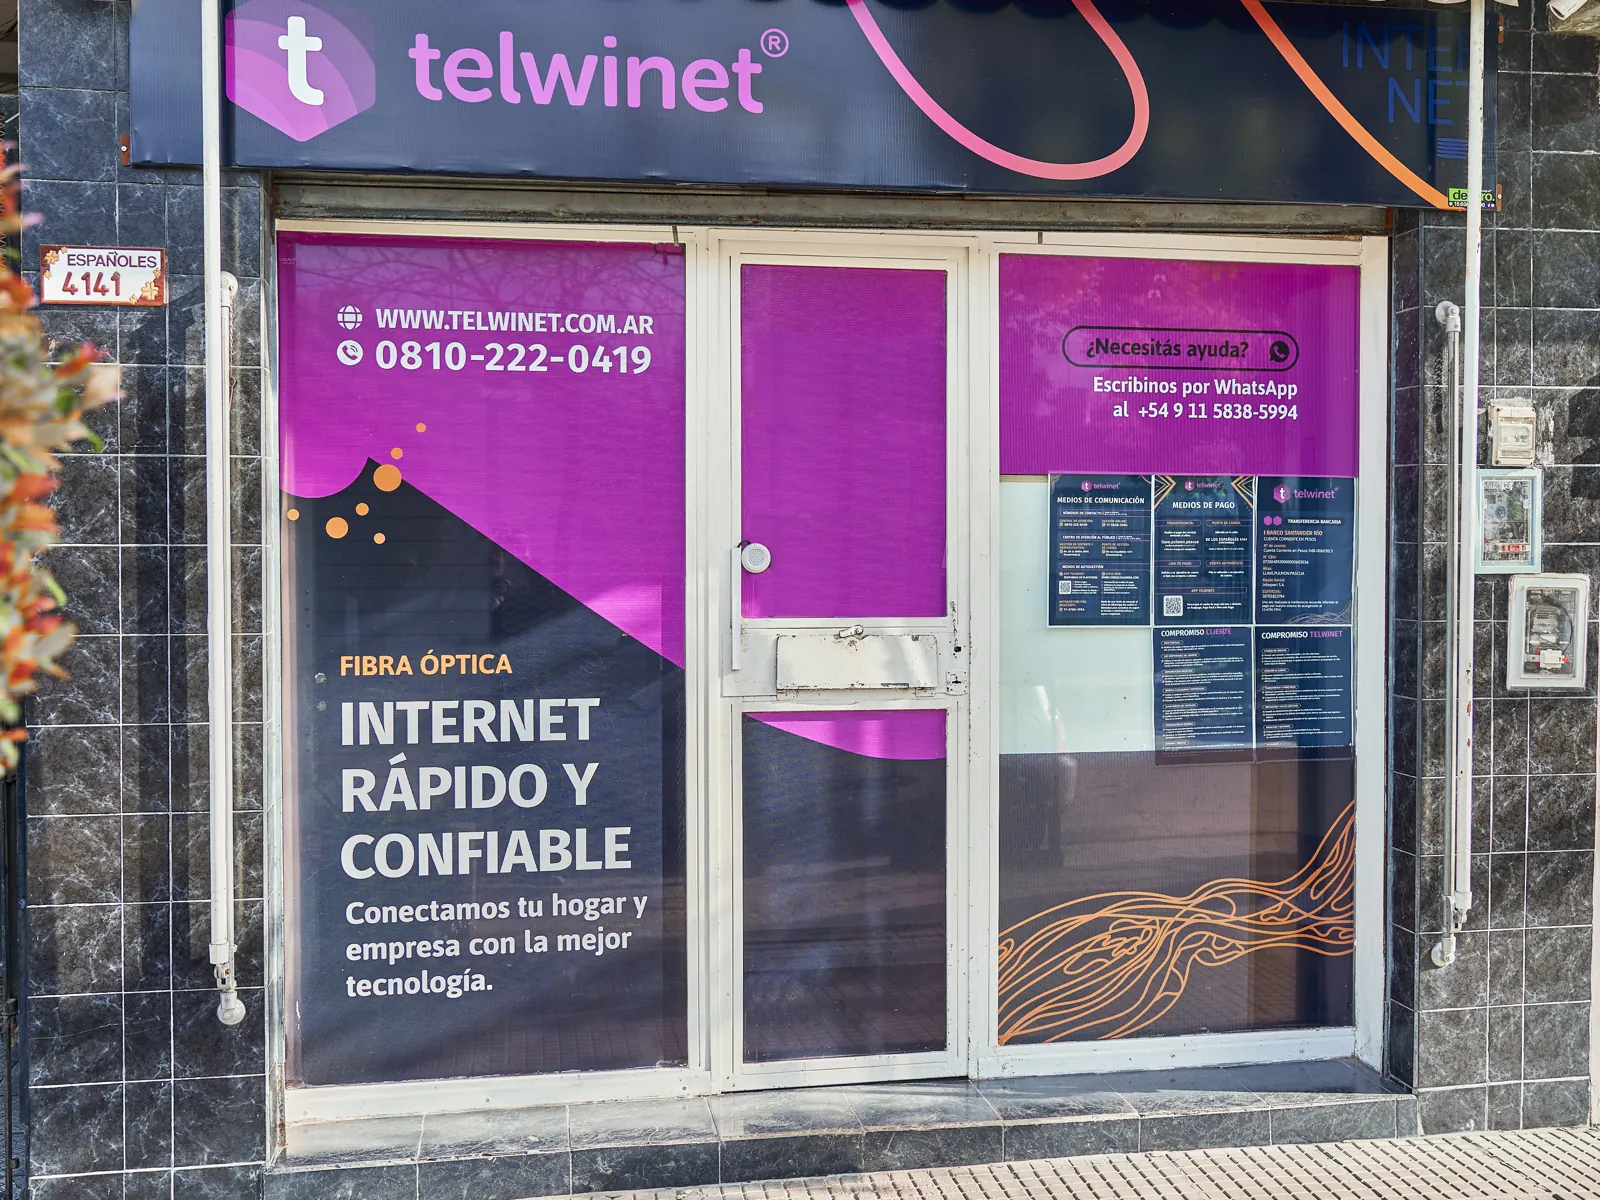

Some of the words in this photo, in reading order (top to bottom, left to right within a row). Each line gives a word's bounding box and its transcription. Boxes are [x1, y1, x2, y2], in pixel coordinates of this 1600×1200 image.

[278, 16, 324, 106] t
[67, 251, 157, 268] ESPAÑOLES
[62, 271, 120, 296] 4141
[375, 308, 654, 335] WWW.TELWINET.COM.AR
[375, 340, 652, 375] 0810-222-0419
[1086, 338, 1181, 358] ¿Necesitás
[1186, 340, 1249, 361] ayuda?
[1093, 376, 1177, 394] Escribinos
[1182, 380, 1210, 397] por
[1214, 378, 1298, 400] WhatsApp
[1113, 401, 1129, 418] al
[1138, 402, 1169, 418] +54
[1173, 402, 1183, 418] 9
[1188, 403, 1208, 419] 11
[1212, 403, 1298, 420] 5838-5994
[1057, 496, 1083, 504] MEDIOS
[1094, 495, 1145, 504] COMUNICACIÓN
[1172, 501, 1201, 509] MEDIOS
[1203, 501, 1213, 509] DE
[1215, 501, 1235, 509] PAGO
[1262, 631, 1308, 639] COMPROMISO
[1309, 630, 1343, 638] TELWINET
[340, 655, 413, 676] FIBRA
[420, 649, 513, 676] ÓPTICA
[341, 697, 600, 746] INTERNET
[342, 751, 548, 813] RÁPIDO
[562, 762, 600, 806] Y
[340, 826, 632, 879] CONFIABLE
[346, 901, 510, 925] Conectamos
[517, 897, 543, 918] tu
[552, 892, 626, 921] hogar
[633, 895, 647, 918] y
[346, 938, 460, 965] empresa
[468, 936, 516, 955] con
[524, 930, 548, 953] la
[557, 926, 632, 956] mejor
[346, 968, 493, 998] tecnología.
